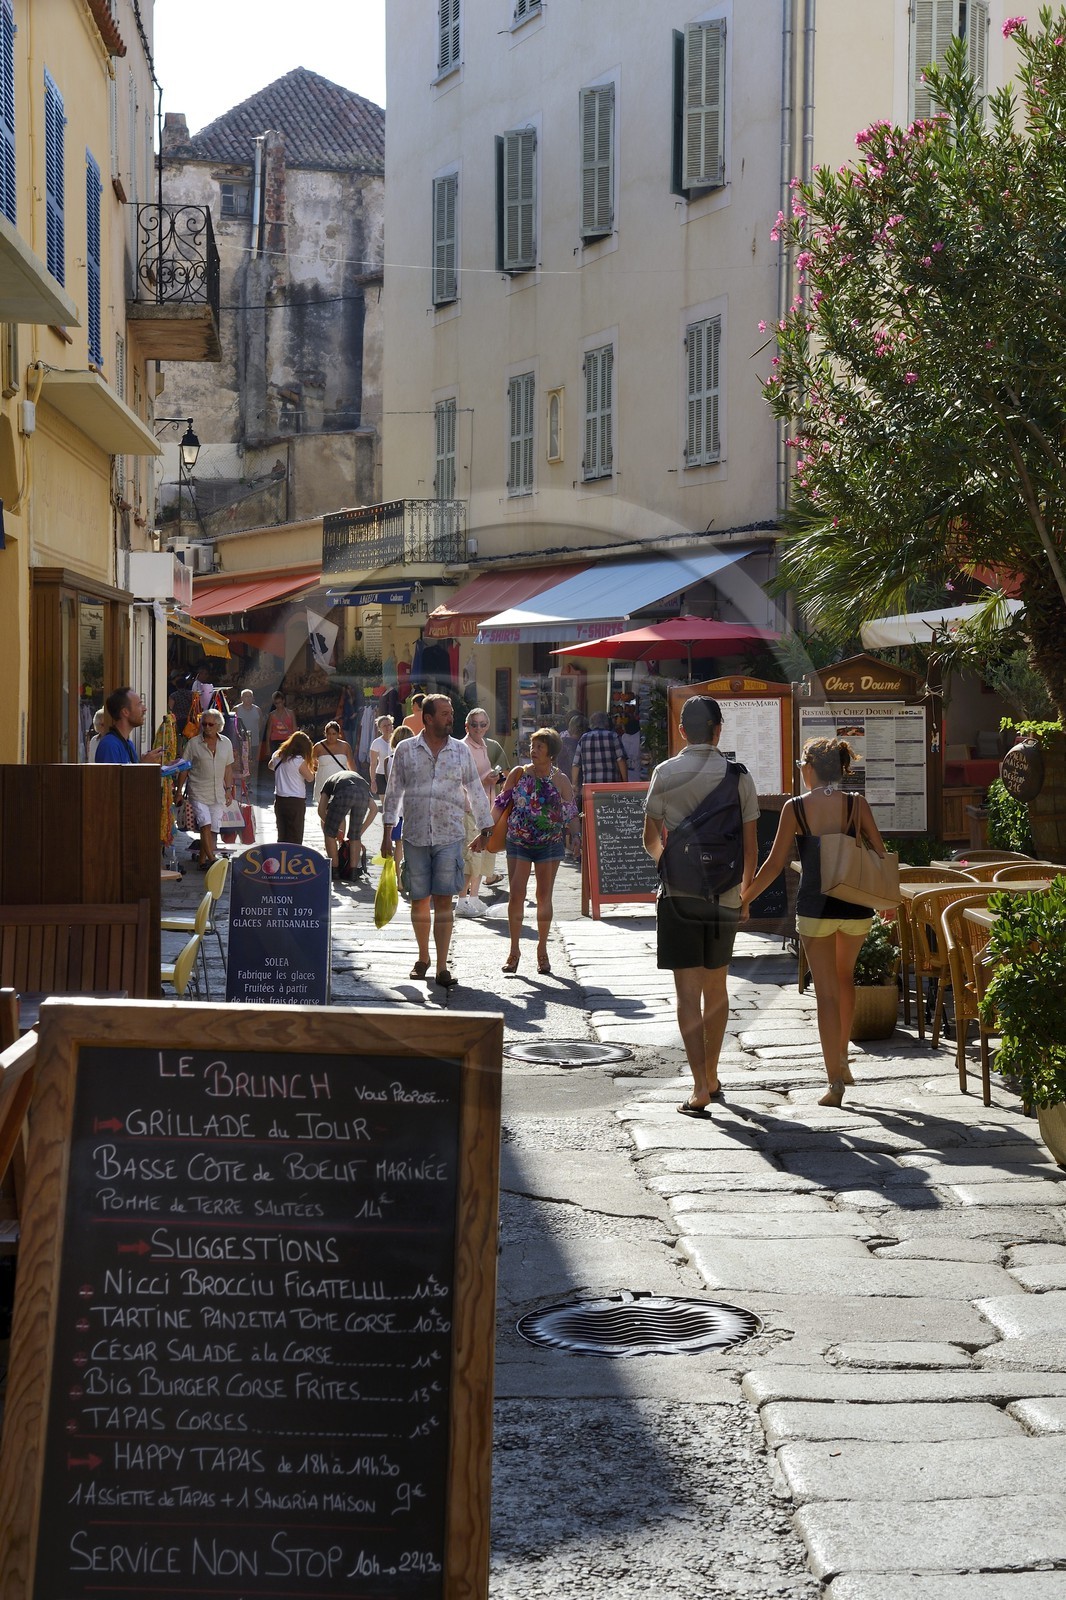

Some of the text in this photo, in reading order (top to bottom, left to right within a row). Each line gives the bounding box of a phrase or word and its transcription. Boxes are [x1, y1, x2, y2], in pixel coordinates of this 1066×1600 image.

[576, 621, 624, 639] T-SHIRTS
[825, 674, 902, 693] Chez Doumé
[1004, 758, 1028, 770] MAISON
[243, 849, 318, 876] Soléa
[240, 908, 313, 917] FONDEE EN 1979
[261, 896, 293, 904] MAISON
[232, 918, 320, 928] GLACES ARTISANALES
[264, 958, 290, 967] SOLEA
[238, 970, 316, 982] Fabrique les glaces
[244, 982, 308, 994] Fruitées à partir
[245, 996, 265, 1004] fruits
[270, 996, 287, 1004] frais
[158, 1051, 196, 1077] LE
[204, 1060, 332, 1100] BRUNCH
[354, 1085, 388, 1102] Vous
[125, 1108, 372, 1140] GRILLADE du JOUR
[92, 1144, 448, 1182] BASSE CÔTE de BOEUF MARINÉE
[96, 1188, 162, 1210] POMME
[170, 1197, 188, 1212] de
[188, 1196, 244, 1215] TERRE
[254, 1192, 325, 1217] SAUTÉES
[150, 1228, 340, 1262] SUGGESTIONS
[90, 1304, 192, 1328] TARTINE
[200, 1306, 288, 1330] PANZETTA
[290, 1308, 342, 1331] TOME
[344, 1312, 397, 1333] CORSE
[91, 1338, 159, 1362] CÉSAR
[166, 1338, 243, 1362] SALADE
[251, 1346, 262, 1362] à
[264, 1342, 280, 1362] la
[282, 1341, 334, 1364] CORSE
[83, 1366, 132, 1394] BIG
[137, 1366, 221, 1396] BURGER
[226, 1374, 288, 1398] CORSE
[296, 1372, 360, 1400] FRITES
[82, 1406, 166, 1430] TAPAS
[175, 1409, 249, 1431] CORSES
[114, 1441, 400, 1477] HAPPY TAPAS de 18h à 19h30
[158, 1491, 174, 1508] de
[171, 1486, 216, 1508] TAPAS
[220, 1492, 235, 1508] +
[236, 1487, 250, 1508] 1
[254, 1487, 318, 1510] SANGRIA
[323, 1491, 376, 1513] MAISON
[391, 1482, 427, 1516] 9€
[69, 1530, 182, 1574] SERVICE
[192, 1537, 258, 1577] NON
[264, 1531, 343, 1578] STOP
[346, 1550, 381, 1578] 10h
